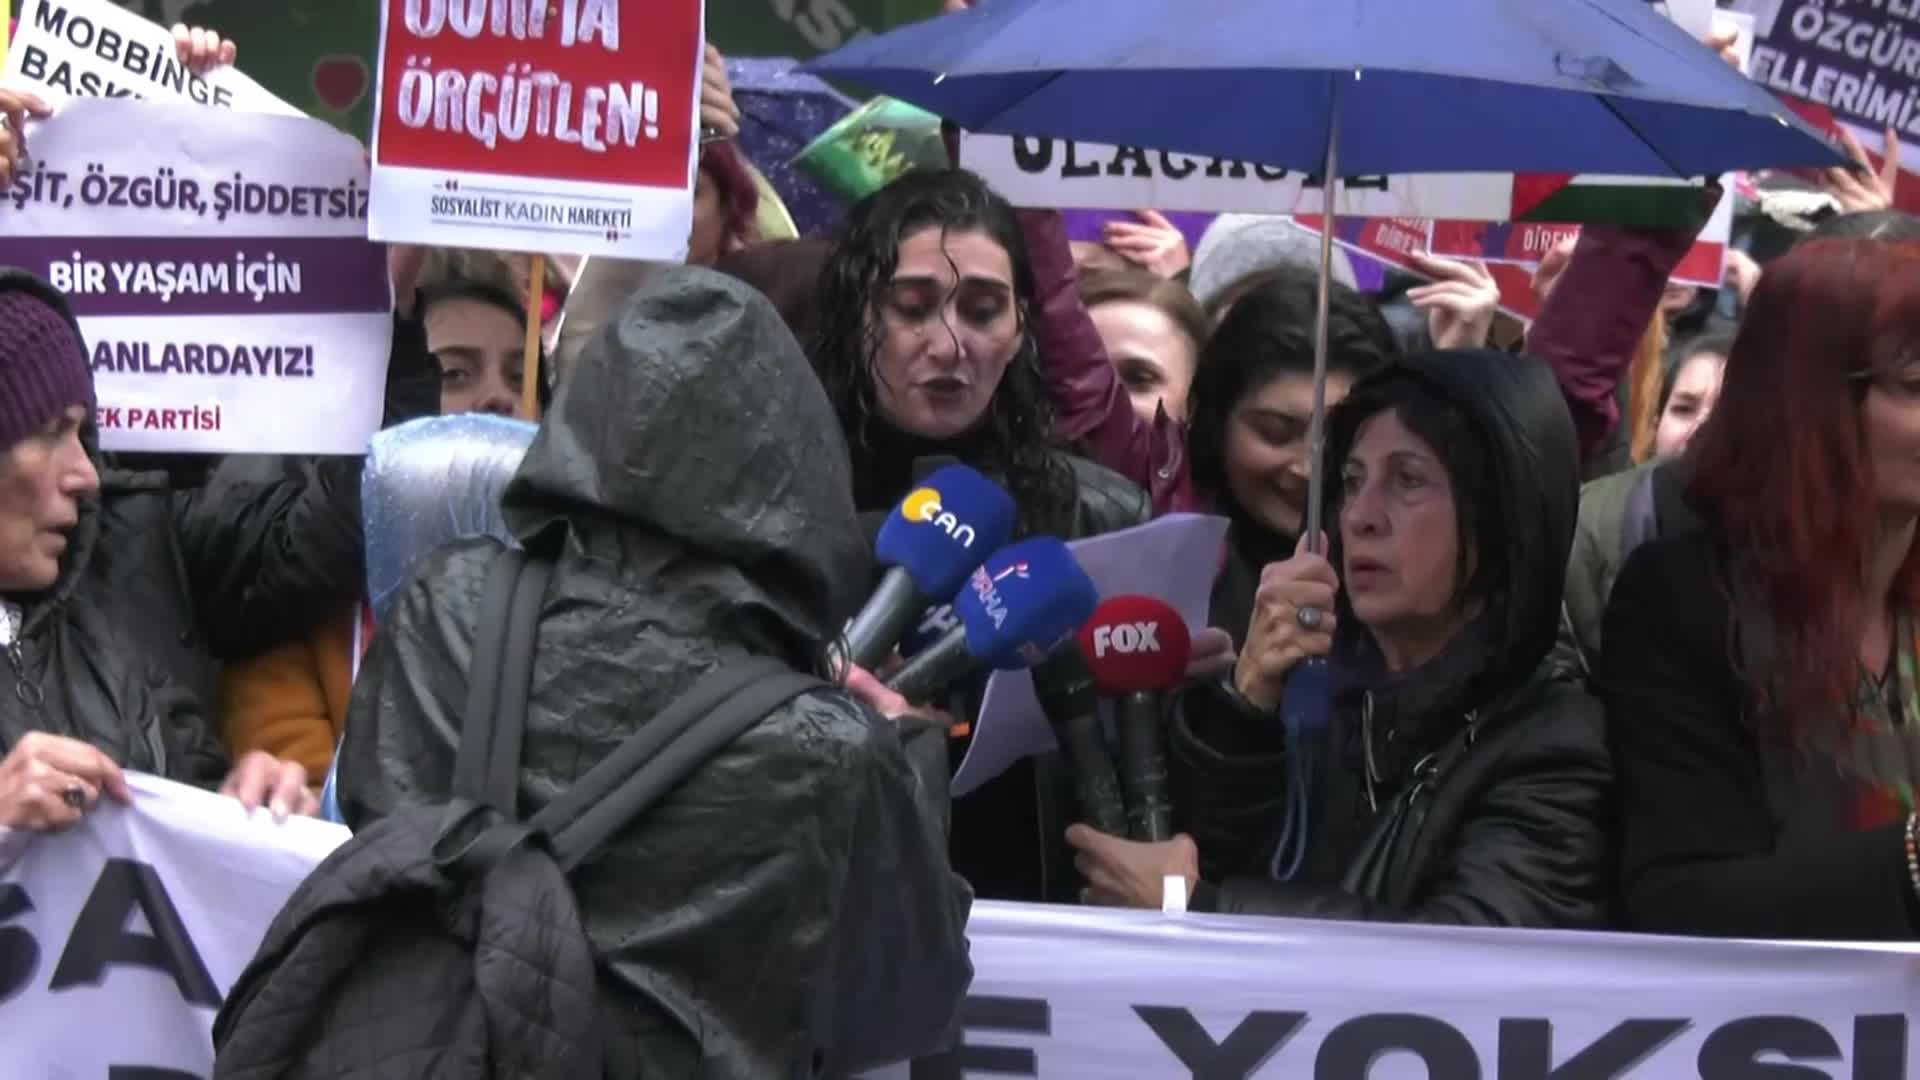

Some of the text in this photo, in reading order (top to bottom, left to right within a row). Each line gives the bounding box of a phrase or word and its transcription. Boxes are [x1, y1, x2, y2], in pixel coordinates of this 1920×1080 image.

[20, 44, 143, 98] BASK
[398, 55, 659, 152] ÖRGÜTLEN!
[81, 163, 207, 216] ÖZGÜR,
[213, 172, 369, 221] ŞİDDETSİZ
[431, 194, 632, 229] SOSYALİST KADIN HAREKETİ
[50, 251, 301, 303] BİR YAŞAM İÇİN
[92, 340, 314, 378] ANLARDAYIZ!
[96, 404, 221, 431] EK PARTİSİ
[1093, 621, 1160, 658] FOX
